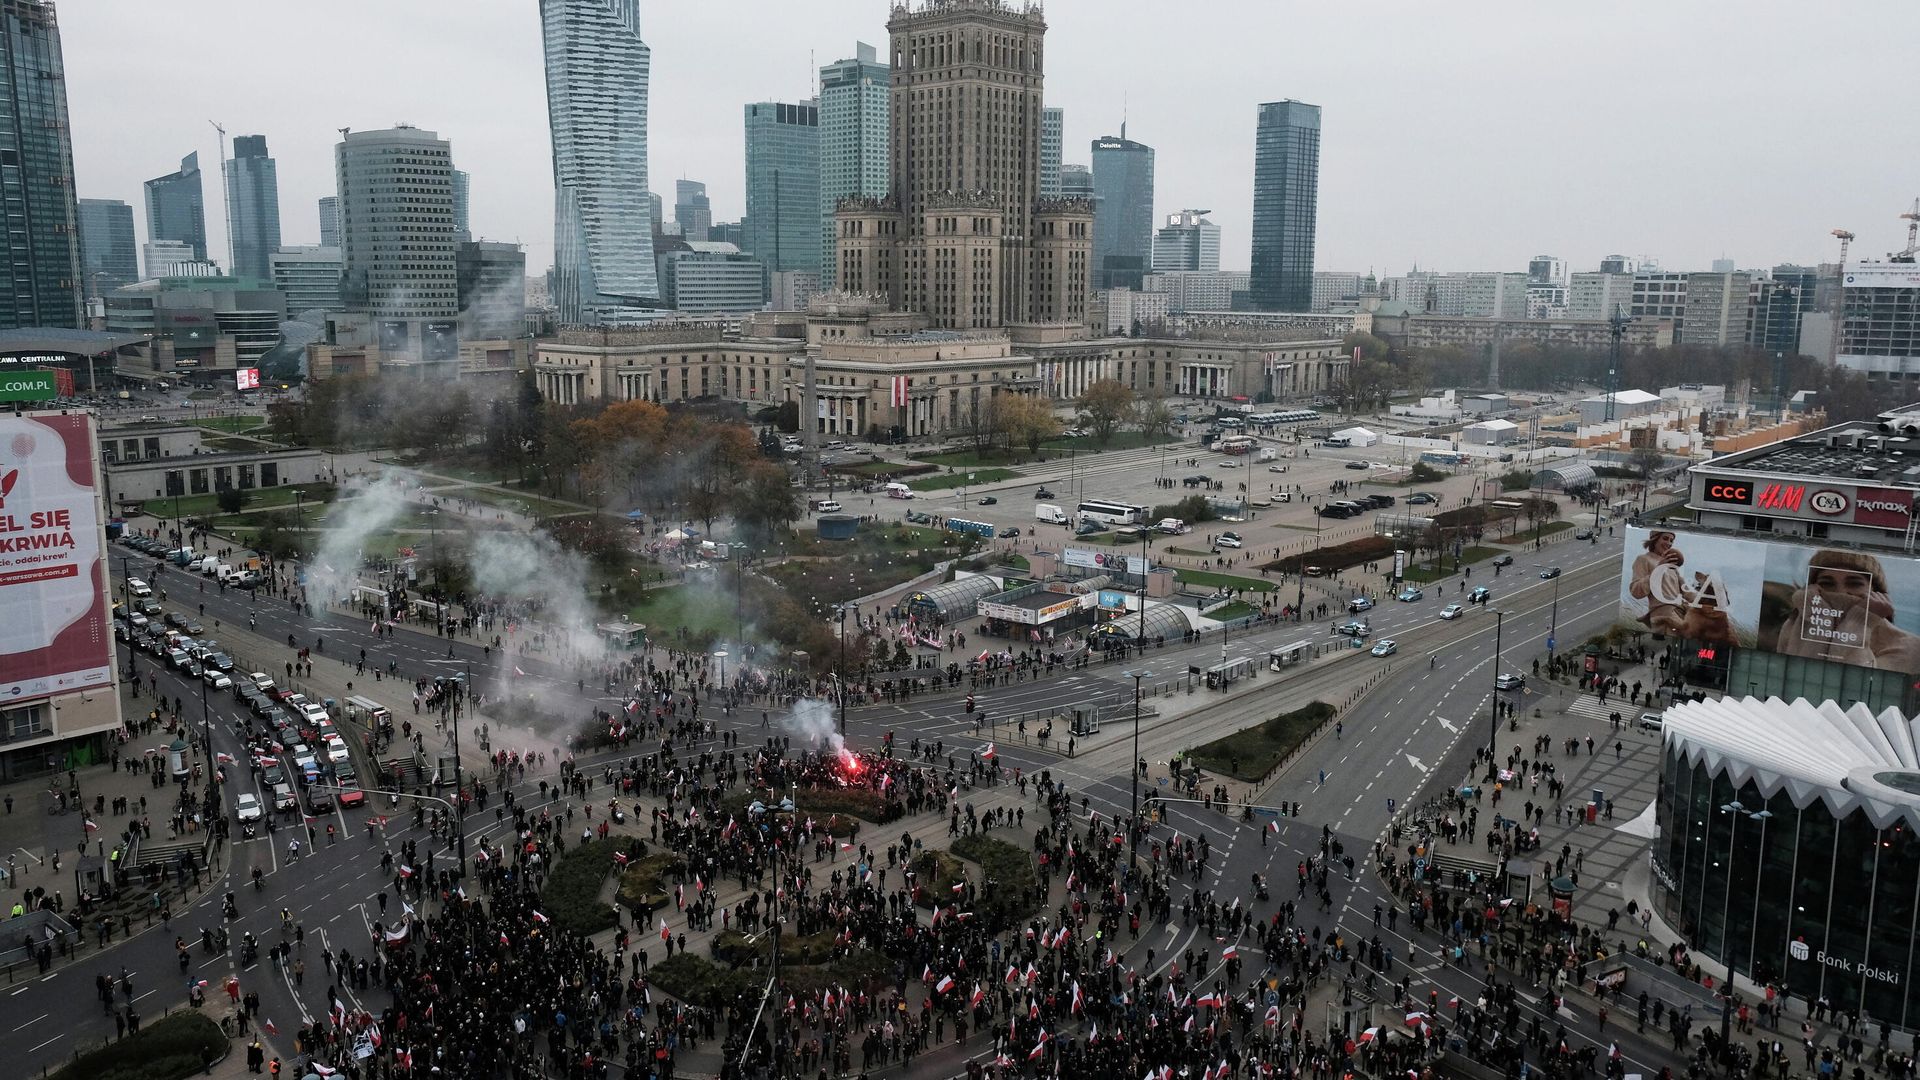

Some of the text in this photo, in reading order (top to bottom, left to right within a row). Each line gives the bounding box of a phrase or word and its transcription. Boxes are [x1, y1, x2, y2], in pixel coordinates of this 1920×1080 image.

[20, 355, 66, 363] CENTRALNA
[0, 381, 51, 392] .COM.PL
[1711, 485, 1746, 500] CCC
[1757, 483, 1806, 513] H&M
[1816, 495, 1842, 510] C&A
[30, 509, 71, 531] SIĘ
[0, 532, 76, 554] KRWIĄ
[15, 555, 41, 565] oddaj
[43, 552, 68, 561] krew!
[1650, 564, 1729, 612] C&A
[1811, 594, 1821, 606] #
[1811, 606, 1844, 618] wear
[1810, 615, 1832, 627] the
[1808, 625, 1858, 642] change
[1816, 951, 1899, 985] Bank Polski
